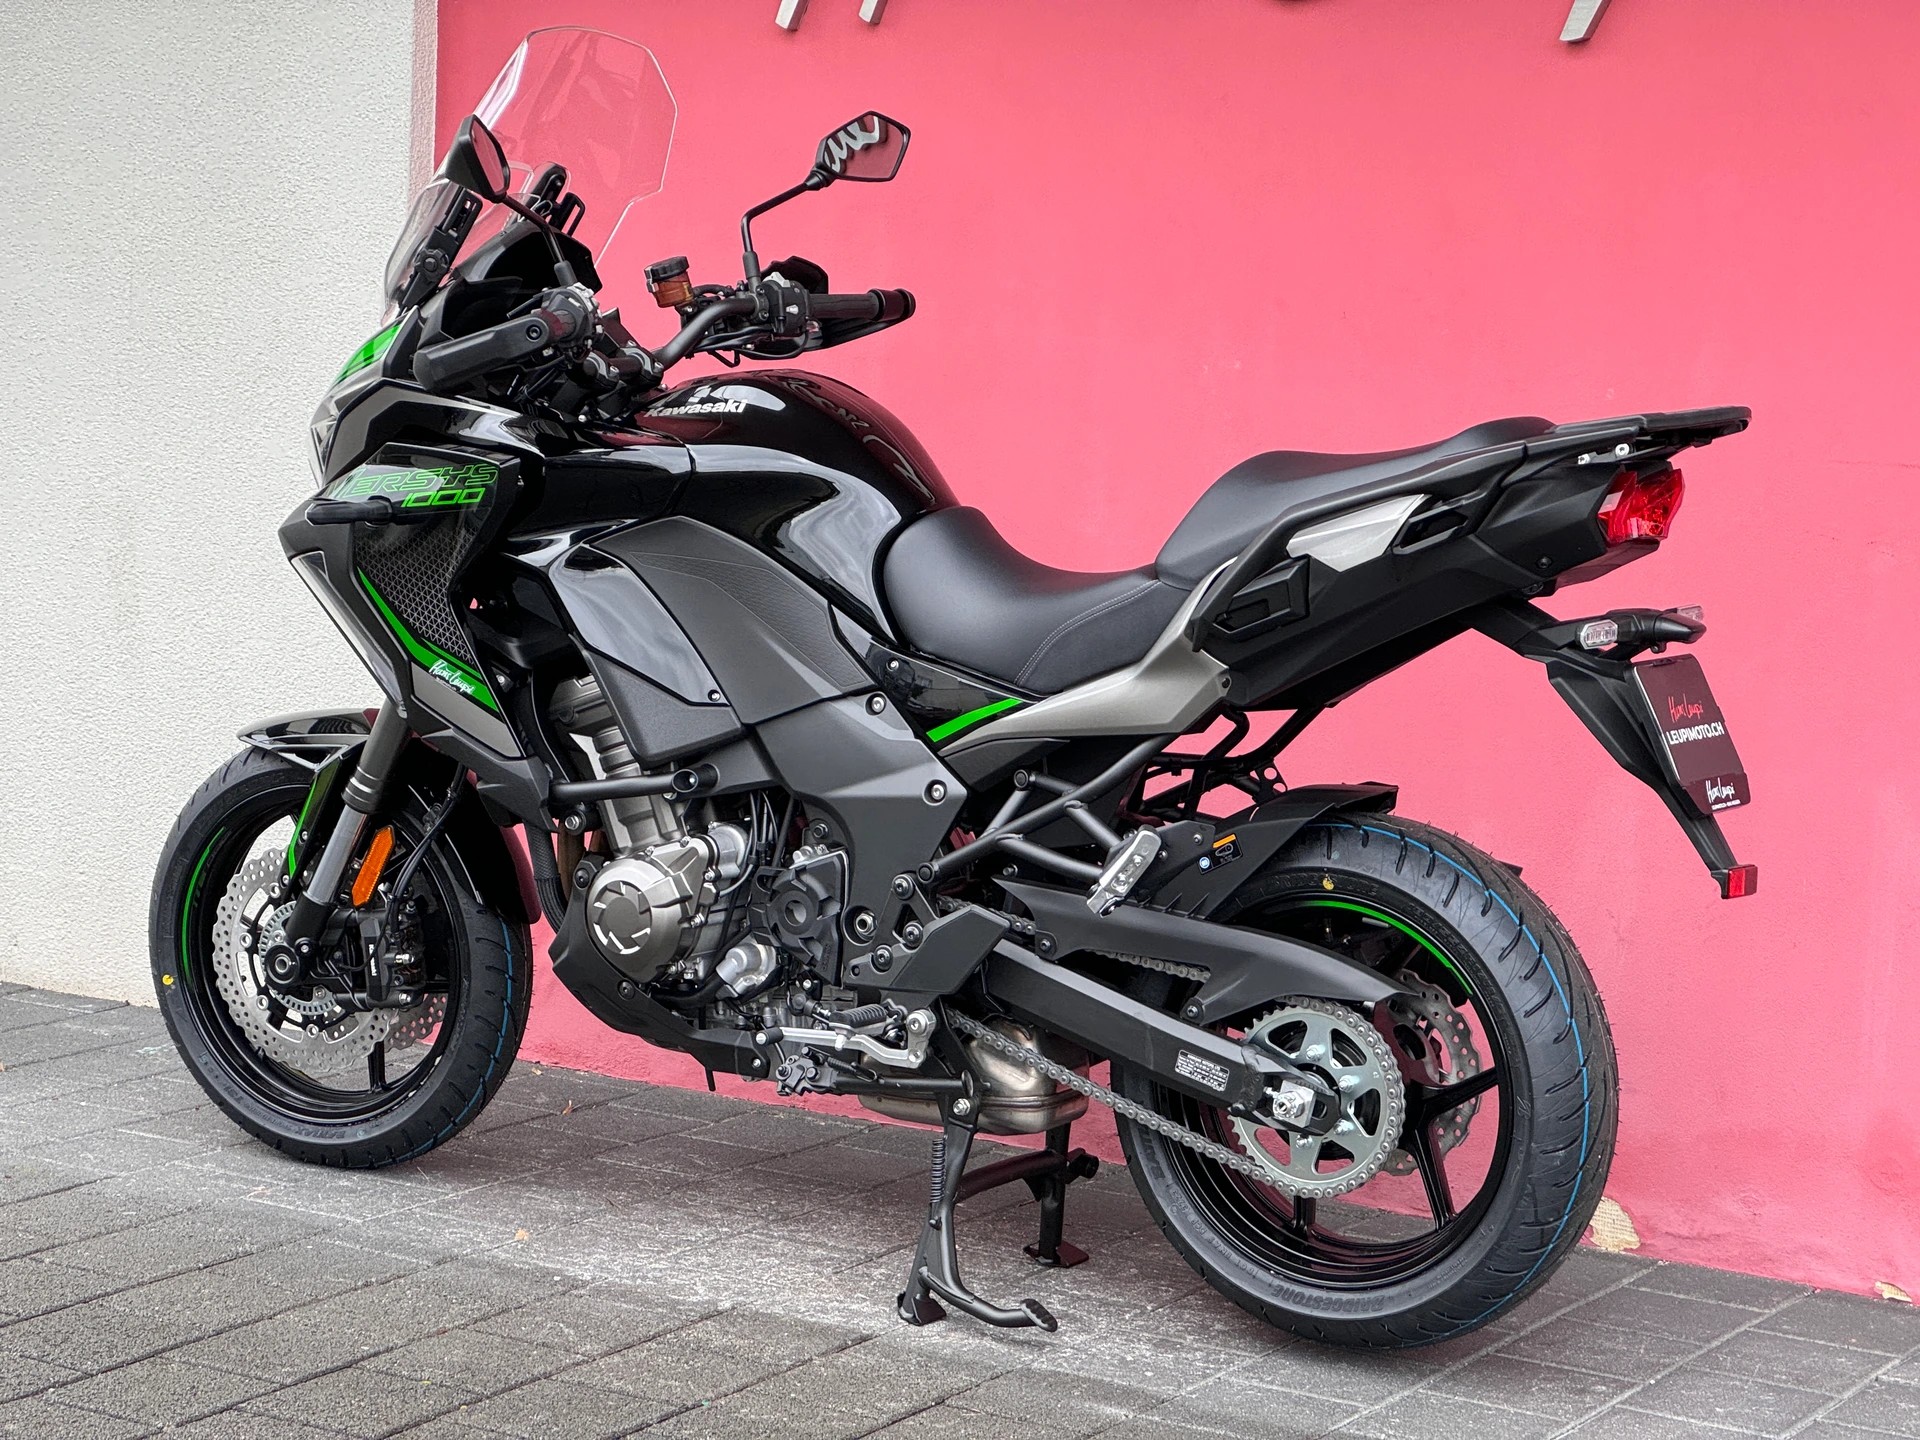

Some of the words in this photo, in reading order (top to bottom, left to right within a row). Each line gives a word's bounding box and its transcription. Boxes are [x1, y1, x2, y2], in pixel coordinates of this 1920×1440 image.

[644, 399, 747, 418] Kawasaki
[329, 464, 499, 499] VERSYS
[401, 488, 486, 508] 1000
[1666, 721, 1725, 745] LEUPIMOTO.CH
[1271, 1284, 1385, 1312] BRIDGESTONE
